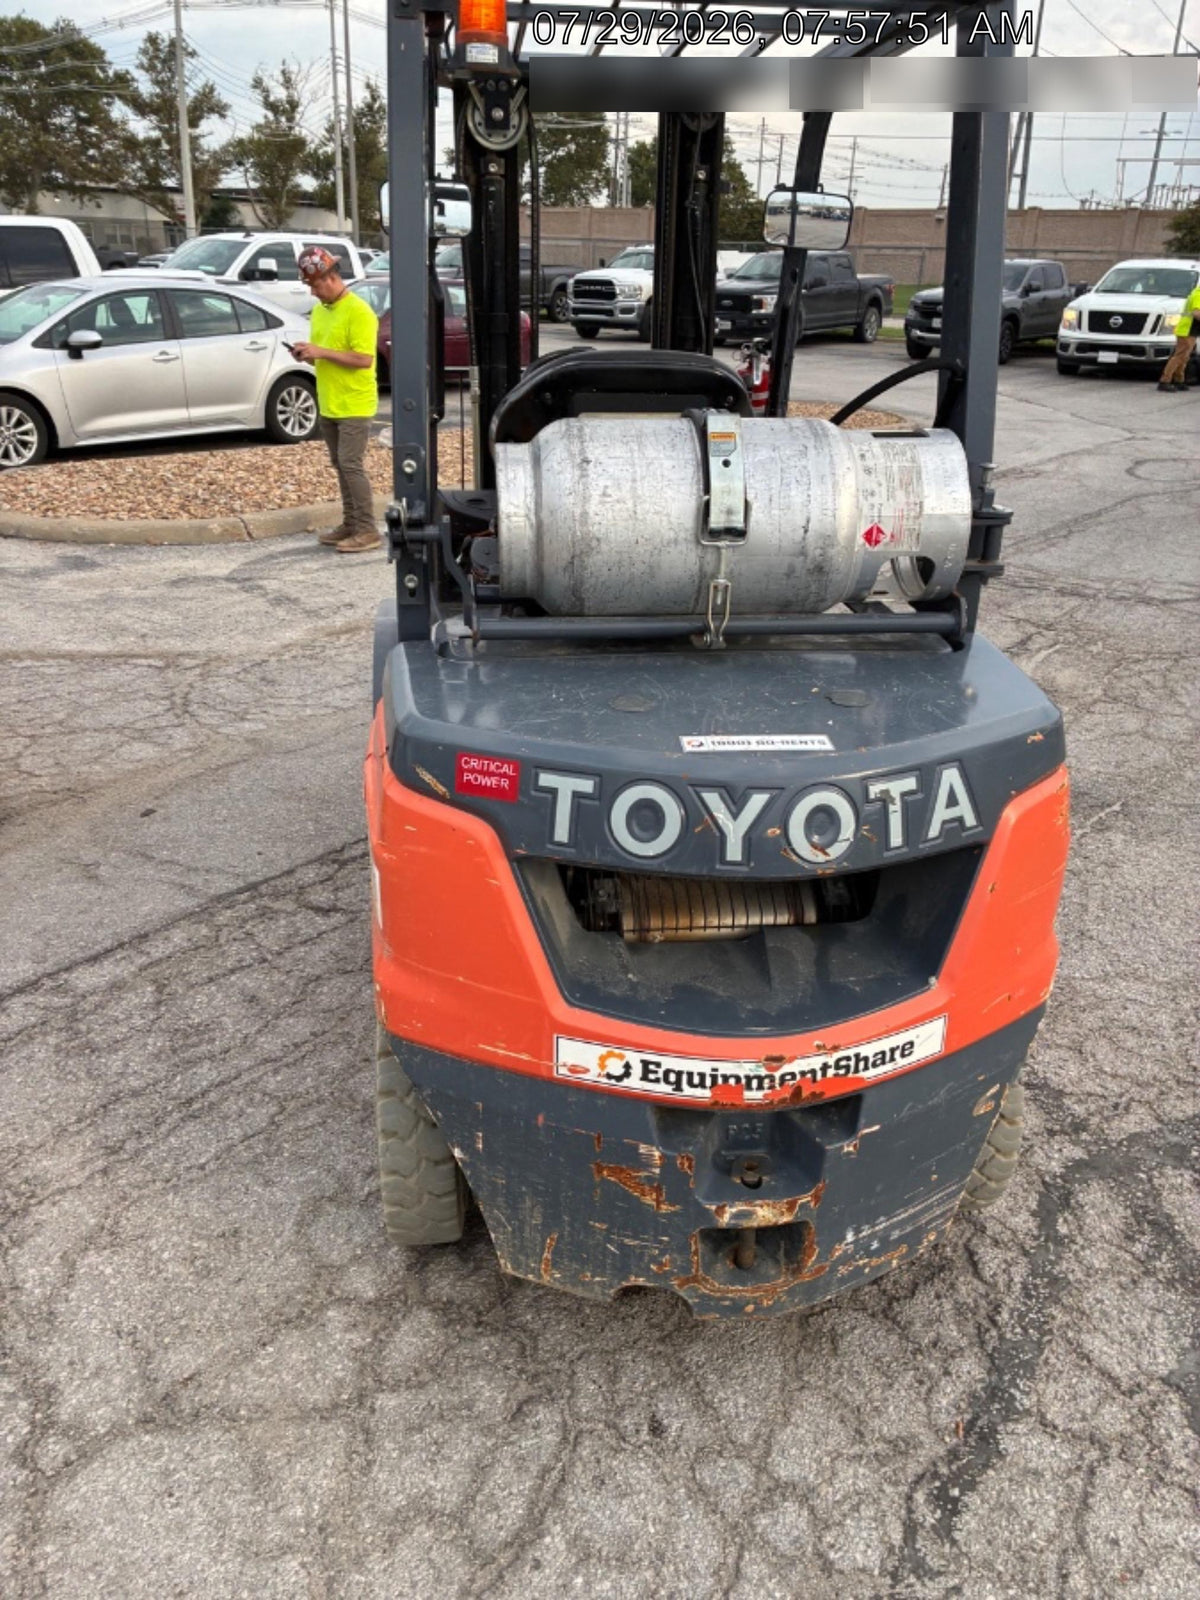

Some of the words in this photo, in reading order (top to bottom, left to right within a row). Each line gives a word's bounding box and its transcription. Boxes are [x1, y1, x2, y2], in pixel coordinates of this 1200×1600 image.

[461, 756, 517, 776] CRITICAL
[463, 772, 510, 790] POWER
[536, 766, 980, 864] TOYOTA
